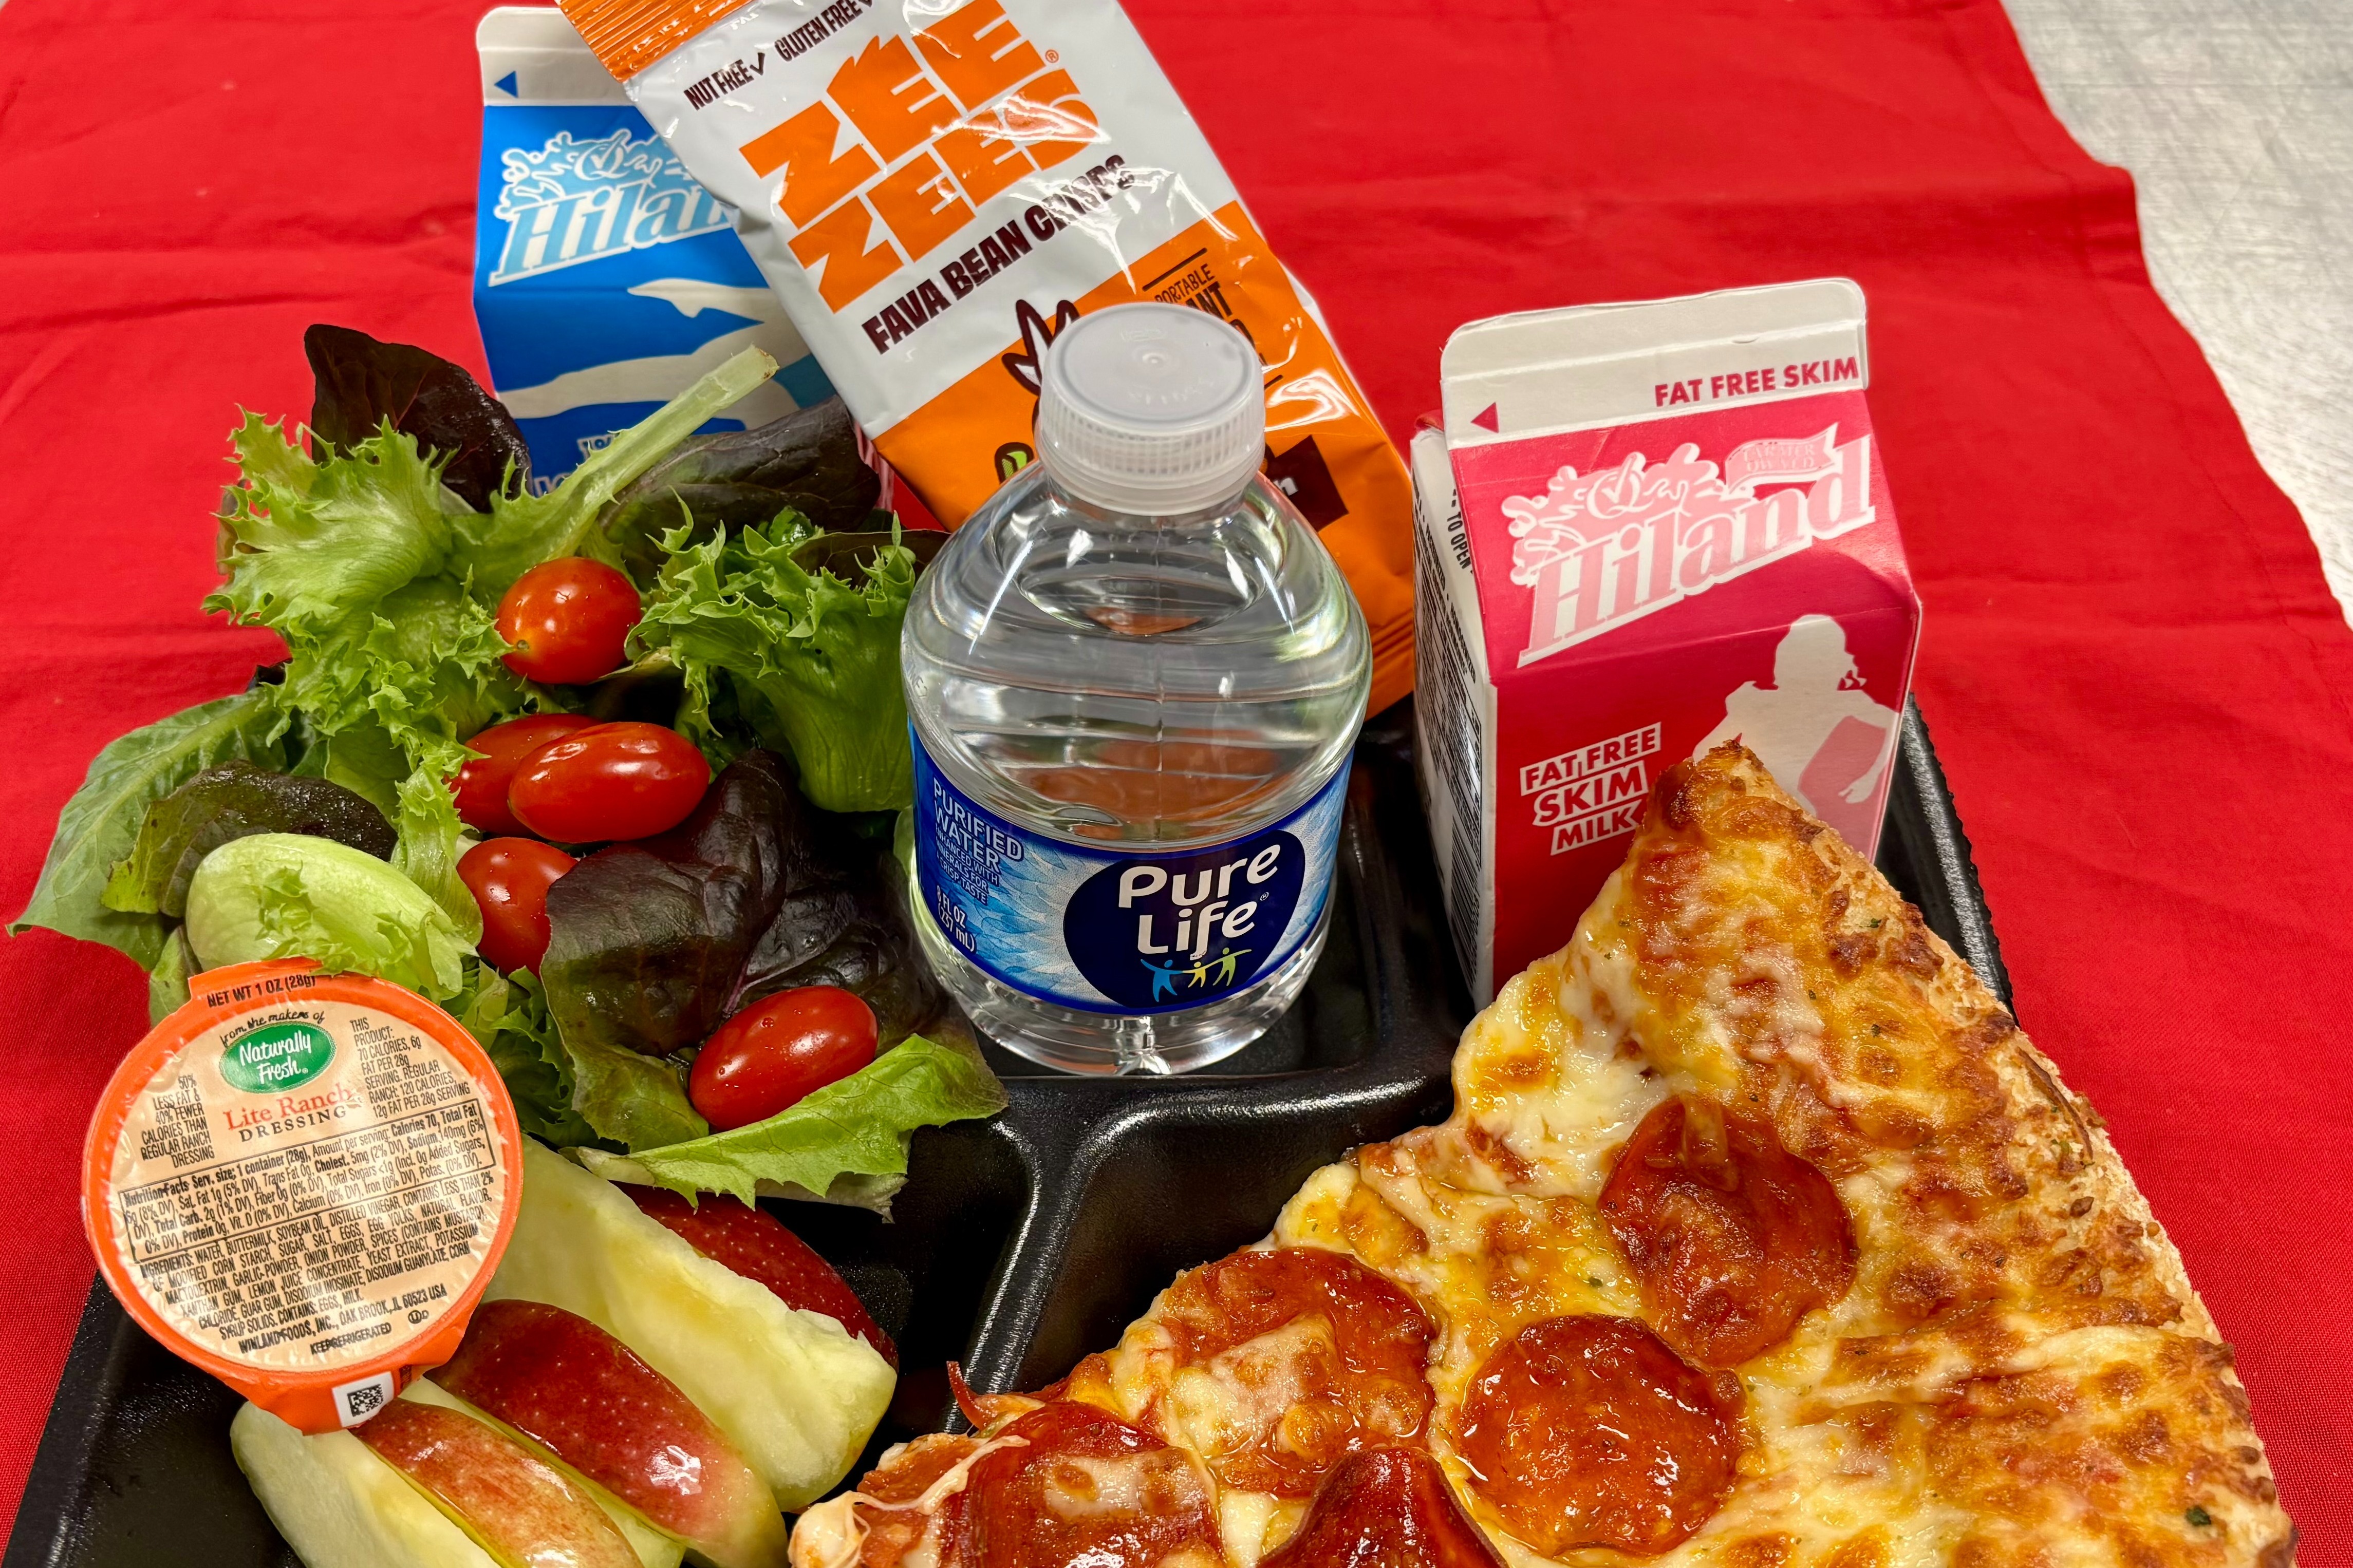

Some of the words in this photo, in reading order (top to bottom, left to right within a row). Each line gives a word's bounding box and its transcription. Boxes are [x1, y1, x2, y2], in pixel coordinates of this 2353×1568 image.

[774, 16, 831, 62] GLUTEN
[820, 0, 863, 33] FREE
[683, 74, 720, 111] NUT
[715, 59, 753, 94] FREE
[739, 0, 1047, 230] ZEE
[788, 68, 1100, 314] ZEES
[493, 180, 730, 282] Hilan
[861, 277, 949, 355] FAVA
[940, 219, 1033, 300] BEAN
[1154, 263, 1215, 304] PORTABLE
[1655, 379, 1703, 407] FAT
[1711, 368, 1776, 399] FREE
[1783, 356, 1859, 388] SKIM
[1447, 512, 1462, 531] TO
[1451, 534, 1472, 569] OPEN
[1526, 433, 1874, 660] Hiland
[1526, 753, 1578, 790] FAT
[1587, 727, 1656, 770] FREE
[1539, 766, 1642, 822] SKIM
[934, 777, 1022, 860] PURIFIED
[935, 800, 1000, 873] WATER
[1557, 807, 1635, 849] MILK
[941, 859, 959, 881] CRISP
[961, 879, 987, 903] TASTE
[971, 872, 988, 890] FOR
[973, 863, 997, 885] WITH
[1119, 844, 1280, 908] Pure
[943, 893, 951, 915] FL
[954, 906, 966, 928] OZ
[1138, 902, 1256, 960] Life
[956, 926, 975, 952] mL)
[208, 990, 230, 1008] NET
[233, 986, 252, 1002] WT
[255, 984, 263, 996] 1
[266, 979, 283, 994] OZ
[285, 974, 316, 992] (28g)
[220, 1025, 248, 1047] from
[248, 1015, 267, 1029] the
[268, 1008, 309, 1022] makers
[313, 1011, 325, 1024] of
[350, 1017, 369, 1032] THIS
[354, 1026, 394, 1046] PRODUCT:
[240, 1030, 311, 1067] Naturally
[256, 1056, 302, 1084] Fresh
[358, 1048, 368, 1061] 70
[369, 1037, 410, 1060] CALORIES,
[410, 1035, 421, 1049] 6g
[362, 1061, 376, 1075] FAT
[377, 1056, 393, 1071] PER
[395, 1053, 409, 1069] 28g
[365, 1069, 402, 1089] SERVING.
[403, 1060, 439, 1079] REGULAR
[369, 1085, 399, 1103] RANCH:
[400, 1082, 414, 1095] 120
[415, 1071, 456, 1092] CALORIES,
[153, 1093, 174, 1110] LESS
[176, 1090, 192, 1105] FAT
[193, 1088, 200, 1101] &
[175, 1102, 203, 1120] FEWER
[223, 1106, 272, 1130] Lite
[277, 1083, 351, 1118] Ranch
[373, 1104, 387, 1120] 12g
[388, 1100, 403, 1113] FAT
[404, 1095, 419, 1109] PER
[421, 1091, 436, 1107] 28g
[437, 1082, 470, 1101] SERVING
[141, 1122, 183, 1144] CALORIES
[184, 1116, 207, 1133] THAN
[141, 1139, 180, 1160] REGULAR
[181, 1131, 211, 1149] RANCH
[239, 1105, 346, 1142] DRESSING
[172, 1145, 214, 1167] DRESSING
[192, 1172, 214, 1188] Serv.
[237, 1164, 242, 1176] 1
[244, 1153, 285, 1174] container
[311, 1138, 342, 1157] Amount
[345, 1138, 357, 1151] per
[359, 1127, 390, 1147] serving:
[390, 1117, 425, 1136] Calories
[425, 1113, 440, 1128] 70,
[441, 1107, 461, 1123] Total
[463, 1104, 476, 1118] Fat
[179, 1209, 202, 1226] Carb.
[203, 1205, 215, 1220] 2g
[255, 1189, 275, 1205] Fiber
[327, 1170, 347, 1186] Total
[348, 1162, 377, 1181] Sugars
[427, 1143, 453, 1160] Added
[454, 1135, 484, 1154] Sugars,
[196, 1189, 210, 1204] Fat
[263, 1169, 285, 1186] Trans
[286, 1166, 299, 1180] Fat
[314, 1153, 349, 1173] Cholest.
[351, 1149, 369, 1165] 5mg
[182, 1223, 214, 1242] Protein
[230, 1215, 244, 1230] Vit.
[246, 1213, 252, 1225] D
[292, 1193, 325, 1213] Calcium
[364, 1178, 380, 1194] Iron
[195, 1244, 225, 1263] WATER,
[226, 1230, 276, 1254] BUTTERMILK,
[276, 1220, 311, 1240] SOYBEAN
[329, 1205, 366, 1225] DISTILLED
[367, 1195, 402, 1216] VINEGAR,
[403, 1185, 440, 1206] CONTAINS
[441, 1180, 459, 1196] LESS
[461, 1175, 480, 1191] THAN
[481, 1171, 493, 1184] 2%
[212, 1258, 235, 1275] CORN
[239, 1246, 274, 1268] STARCH,
[278, 1237, 308, 1257] SUGAR,
[313, 1230, 335, 1248] SALT,
[340, 1222, 363, 1240] EGGS,
[368, 1217, 384, 1232] EGG
[388, 1207, 416, 1226] YOLKS,
[420, 1197, 456, 1217] NATURAL
[265, 1256, 301, 1277] POWDER,
[304, 1248, 329, 1266] ONION
[332, 1238, 368, 1259] POWDER,
[371, 1229, 398, 1247] SPICES
[401, 1217, 442, 1241] (CONTAINS
[223, 1289, 245, 1306] GUM,
[248, 1280, 276, 1298] LEMON
[280, 1272, 303, 1289] JUICE
[306, 1256, 364, 1282] CONCENTRATE,
[367, 1248, 393, 1265] YEAST
[396, 1237, 432, 1257] EXTRACT,
[435, 1222, 479, 1245] POTASSIUM
[240, 1300, 263, 1318] GUAR
[264, 1294, 284, 1311] GUM,
[285, 1282, 323, 1304] DISODIUM
[324, 1271, 365, 1294] INOSINATE,
[366, 1261, 403, 1281] DISODIUM
[449, 1242, 470, 1257] CORN
[219, 1321, 246, 1339] SYRUP
[246, 1313, 277, 1332] SOLIDS.
[277, 1301, 318, 1323] CONTAINS:
[318, 1294, 341, 1312] EGGS,
[282, 1320, 315, 1340] FOODS,
[339, 1309, 357, 1324] OAK
[402, 1289, 428, 1307] 60523
[428, 1283, 446, 1299] USA
